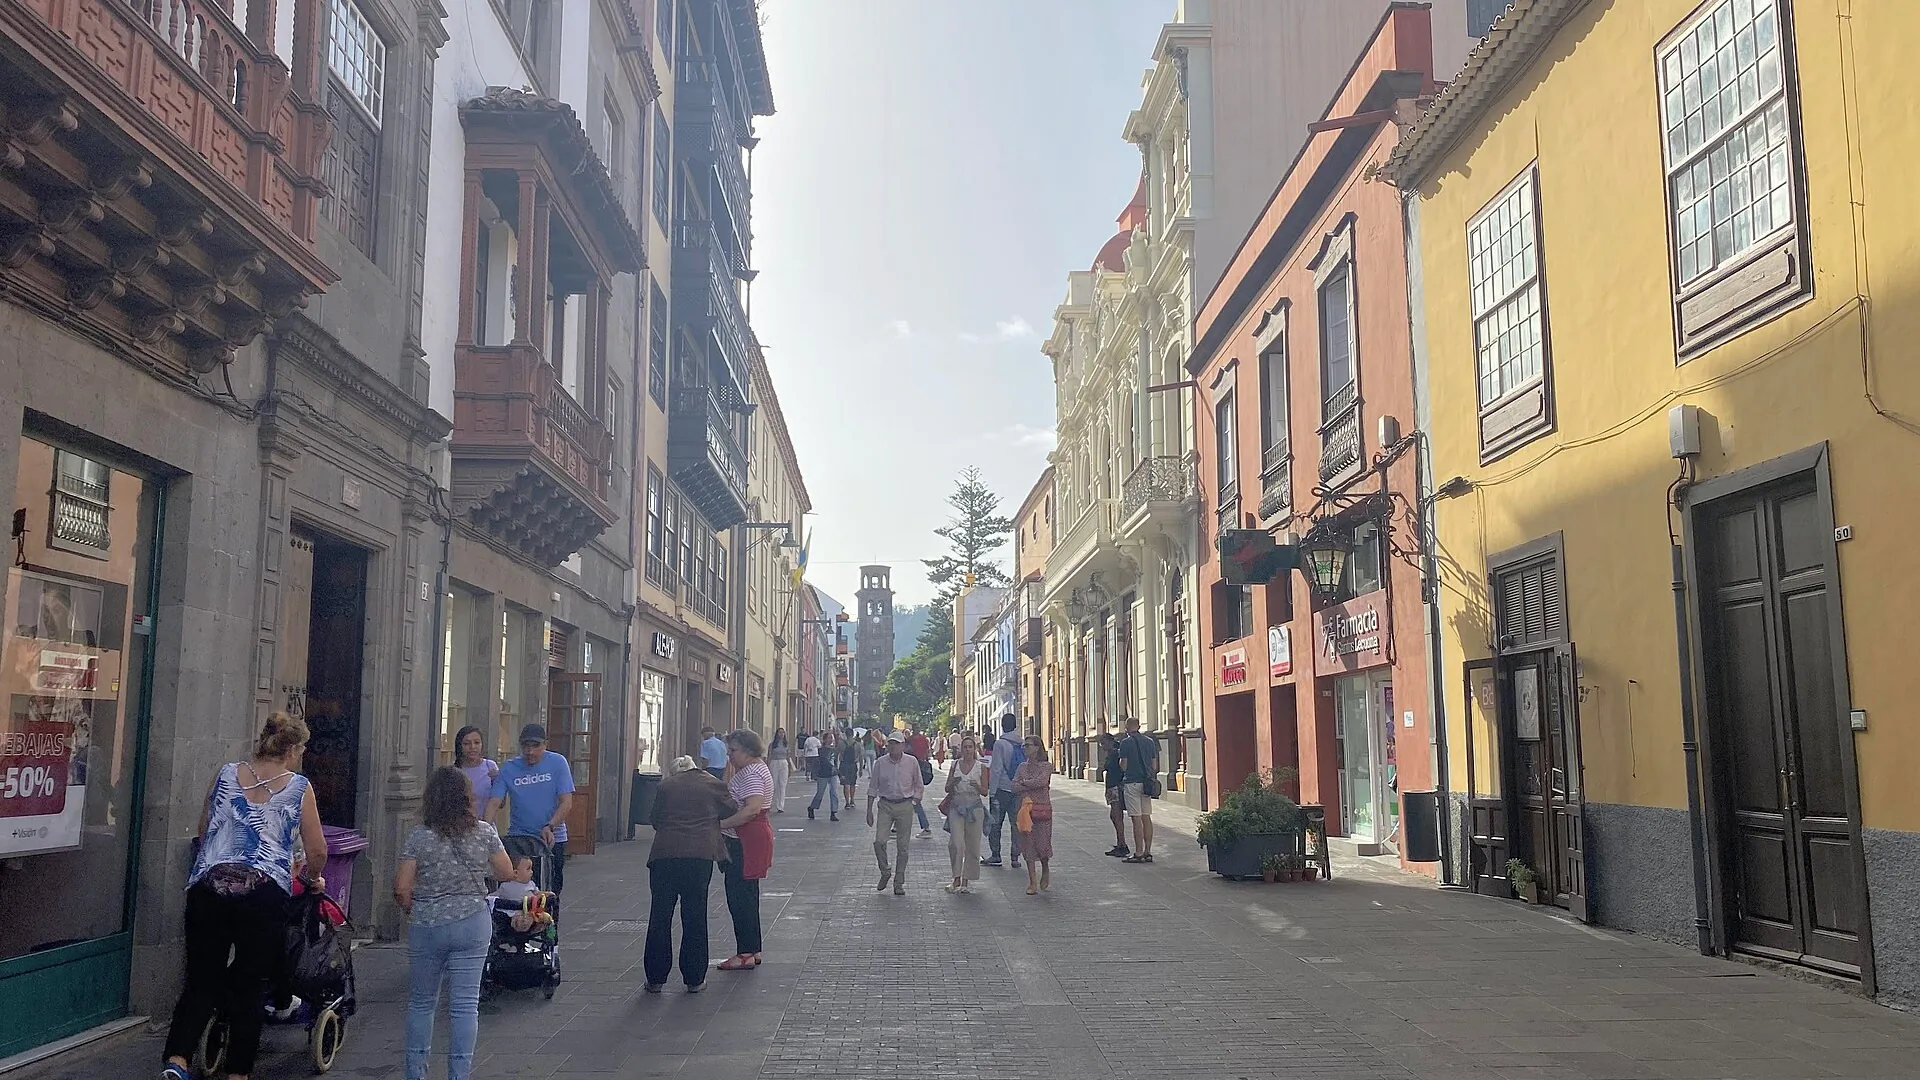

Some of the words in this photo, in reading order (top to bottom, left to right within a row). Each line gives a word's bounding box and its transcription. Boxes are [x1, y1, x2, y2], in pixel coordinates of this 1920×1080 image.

[1836, 528, 1849, 539] 50
[1336, 604, 1378, 640] Farmacia
[514, 773, 552, 786] adidas
